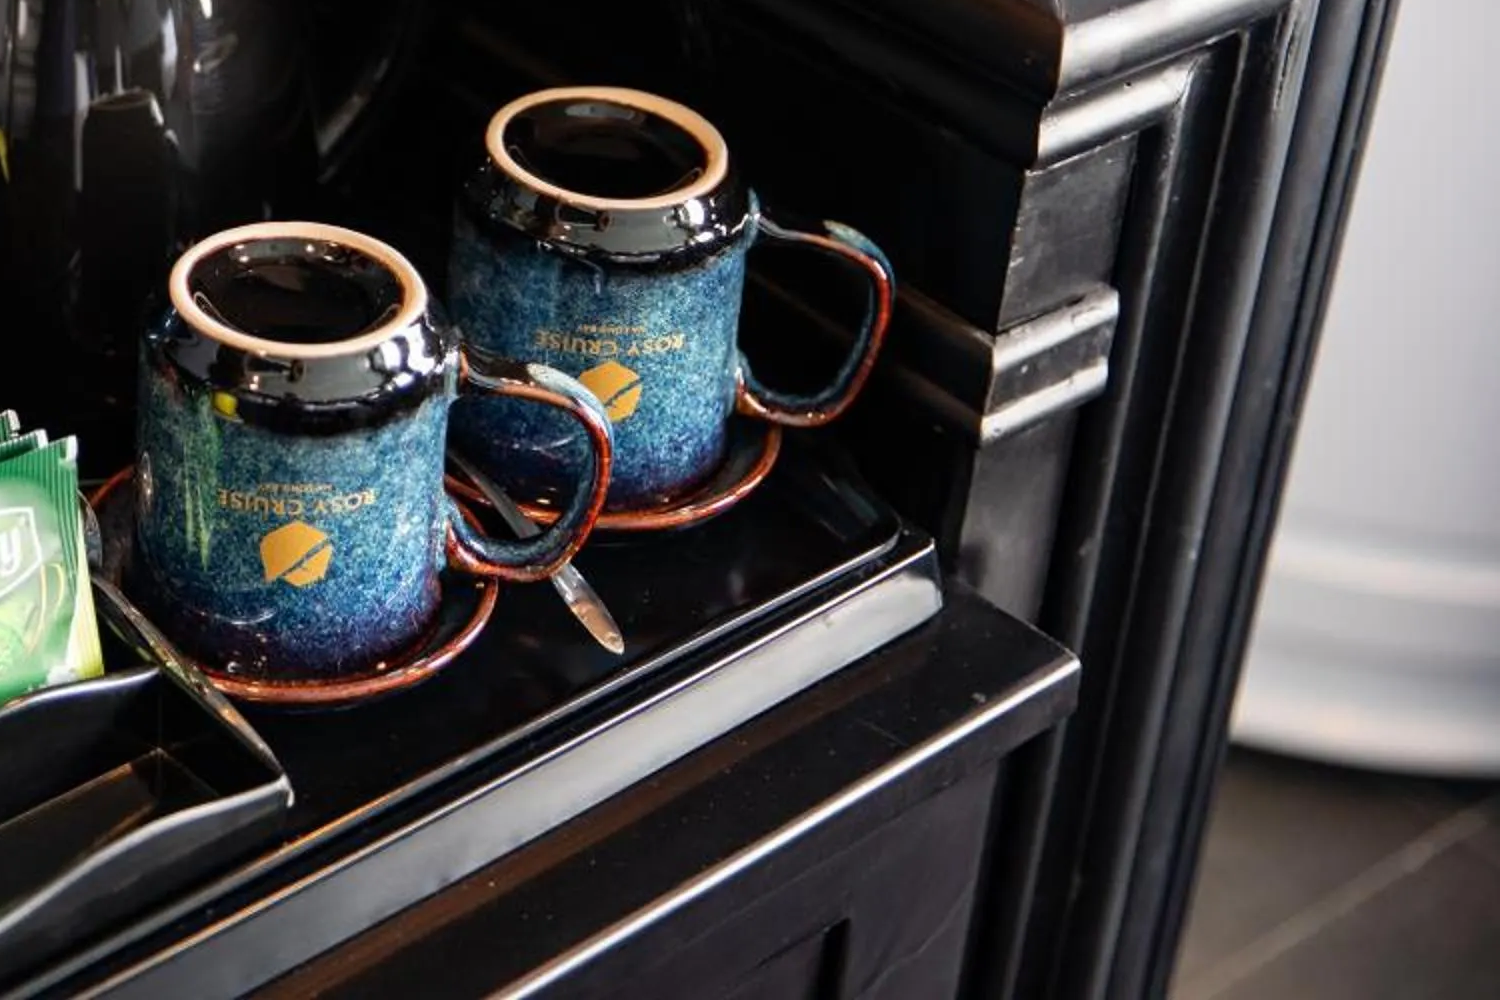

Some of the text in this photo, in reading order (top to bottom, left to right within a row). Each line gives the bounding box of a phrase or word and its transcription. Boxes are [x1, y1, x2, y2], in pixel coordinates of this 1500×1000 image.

[534, 329, 686, 357] ROSY CRUISE
[217, 487, 378, 517] ROSY CRUISE
